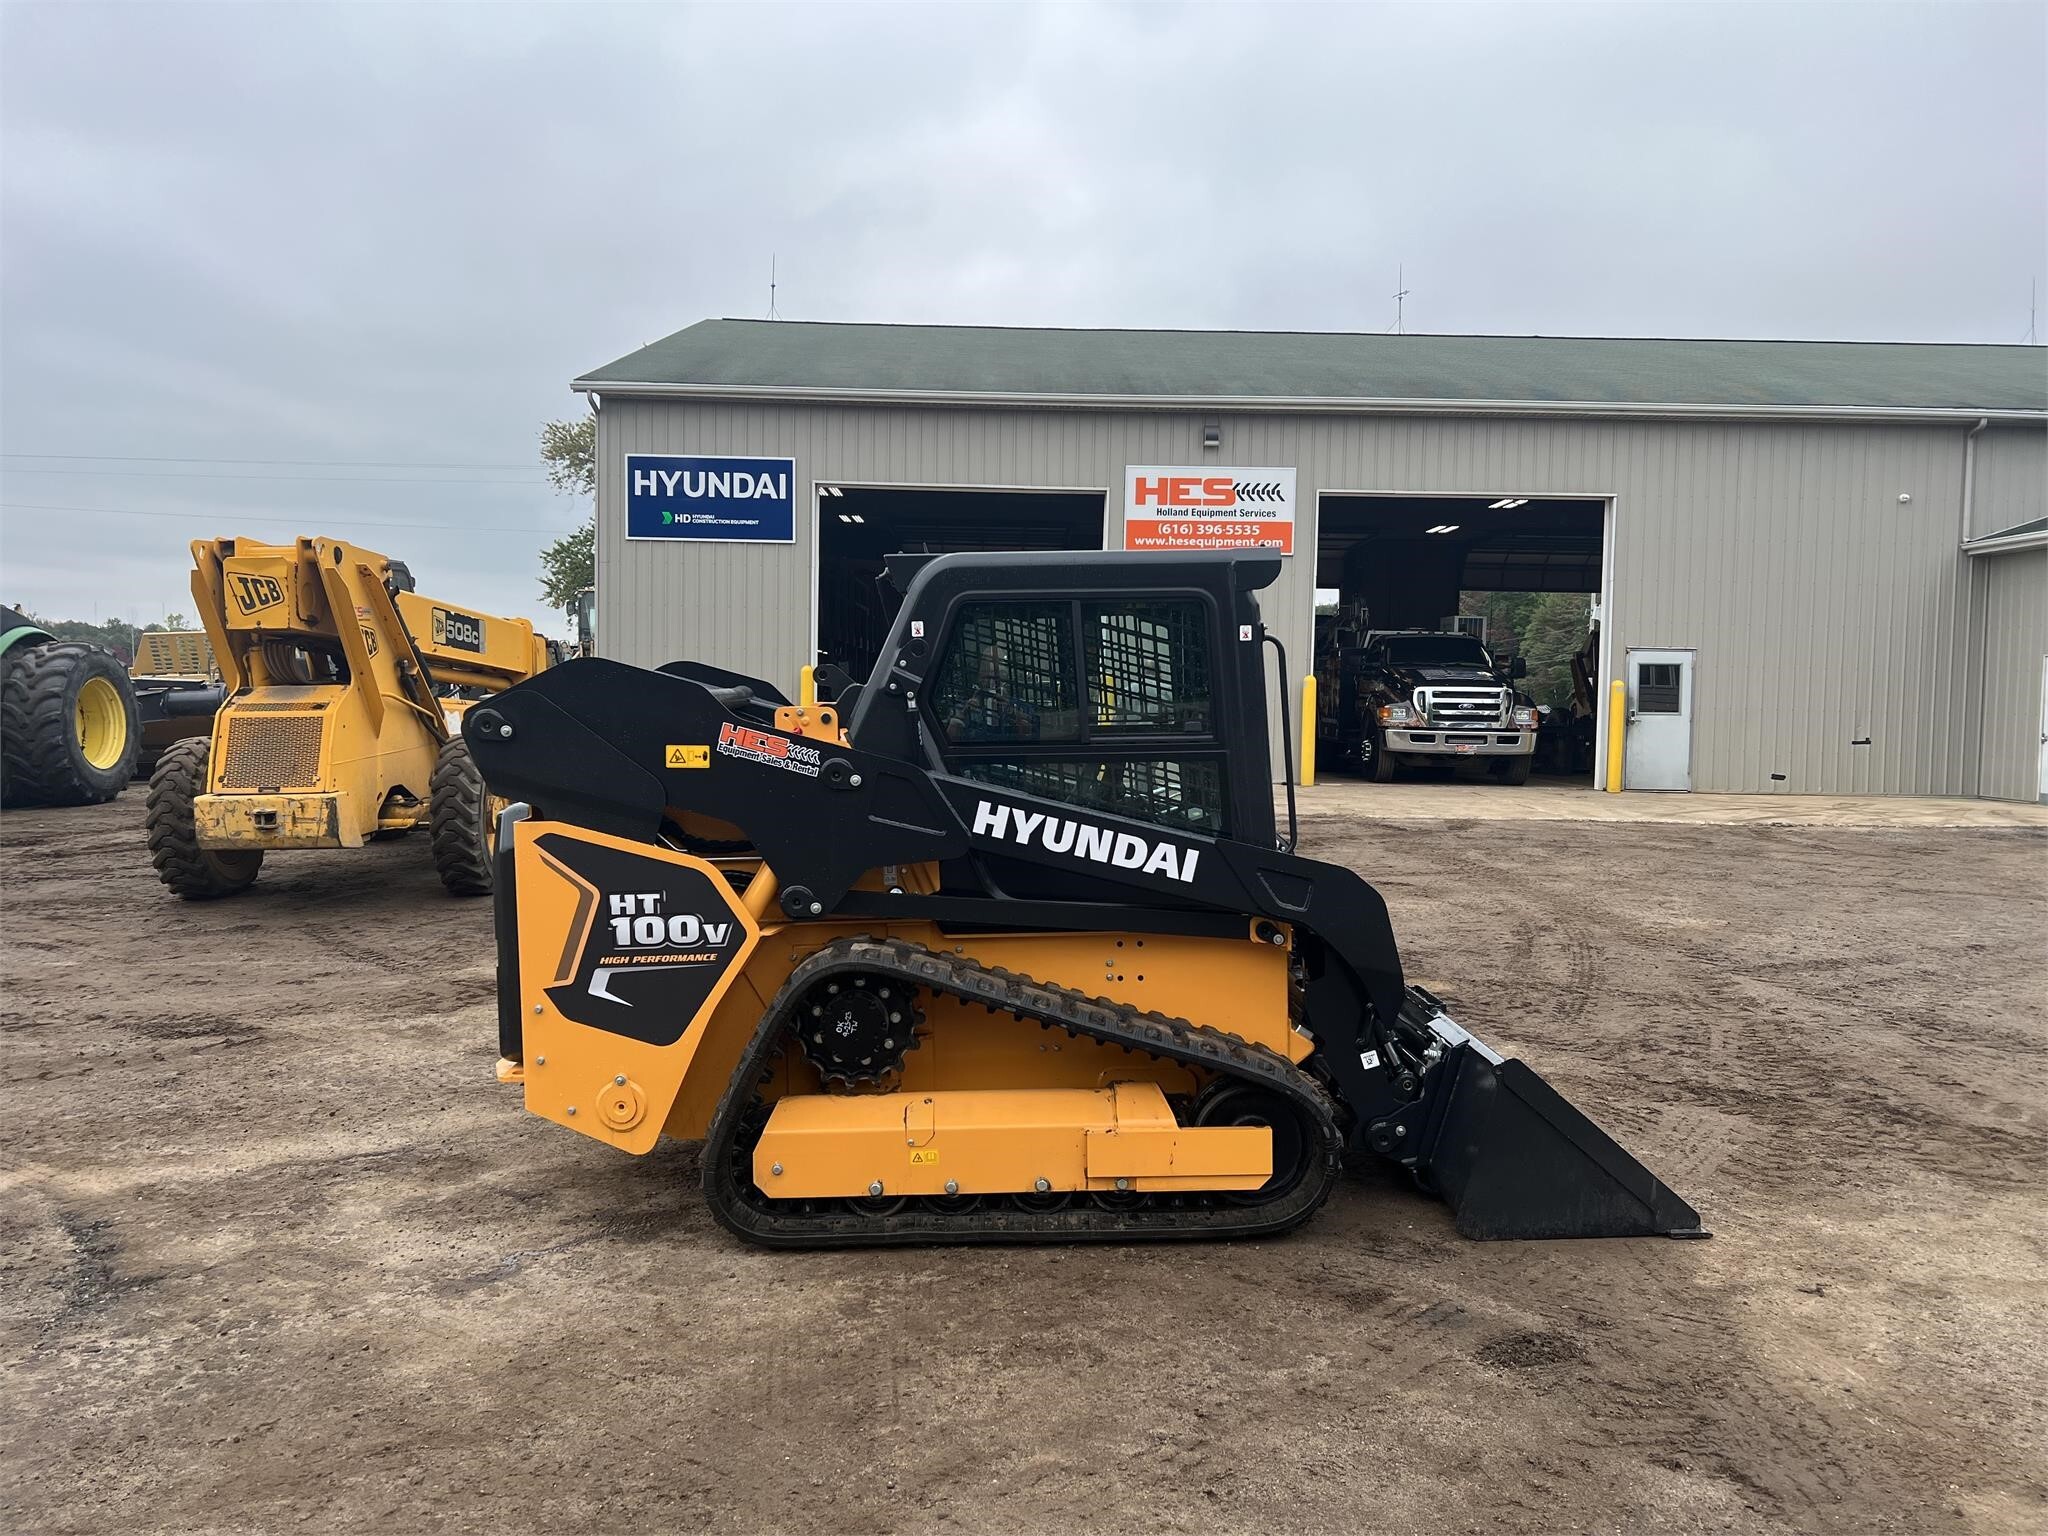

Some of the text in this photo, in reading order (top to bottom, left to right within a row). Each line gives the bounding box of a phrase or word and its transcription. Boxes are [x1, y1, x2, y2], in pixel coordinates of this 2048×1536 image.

[634, 470, 787, 499] HYUNDAI
[1135, 477, 1236, 506] HES
[674, 513, 691, 523] HD
[1156, 508, 1277, 518] Holland Equipment Services
[1135, 535, 1284, 548] www.hesequipment.com
[1158, 523, 1193, 536] (616)
[236, 576, 281, 611] JCB
[361, 628, 377, 656] CB
[721, 723, 789, 759] HES
[718, 743, 819, 776] Equipment Sales & Rental
[972, 800, 1200, 883] HYUNDAI
[609, 893, 661, 915] HT
[599, 953, 718, 965] HIGH PERFORMANCE
[835, 1020, 844, 1033] OK
